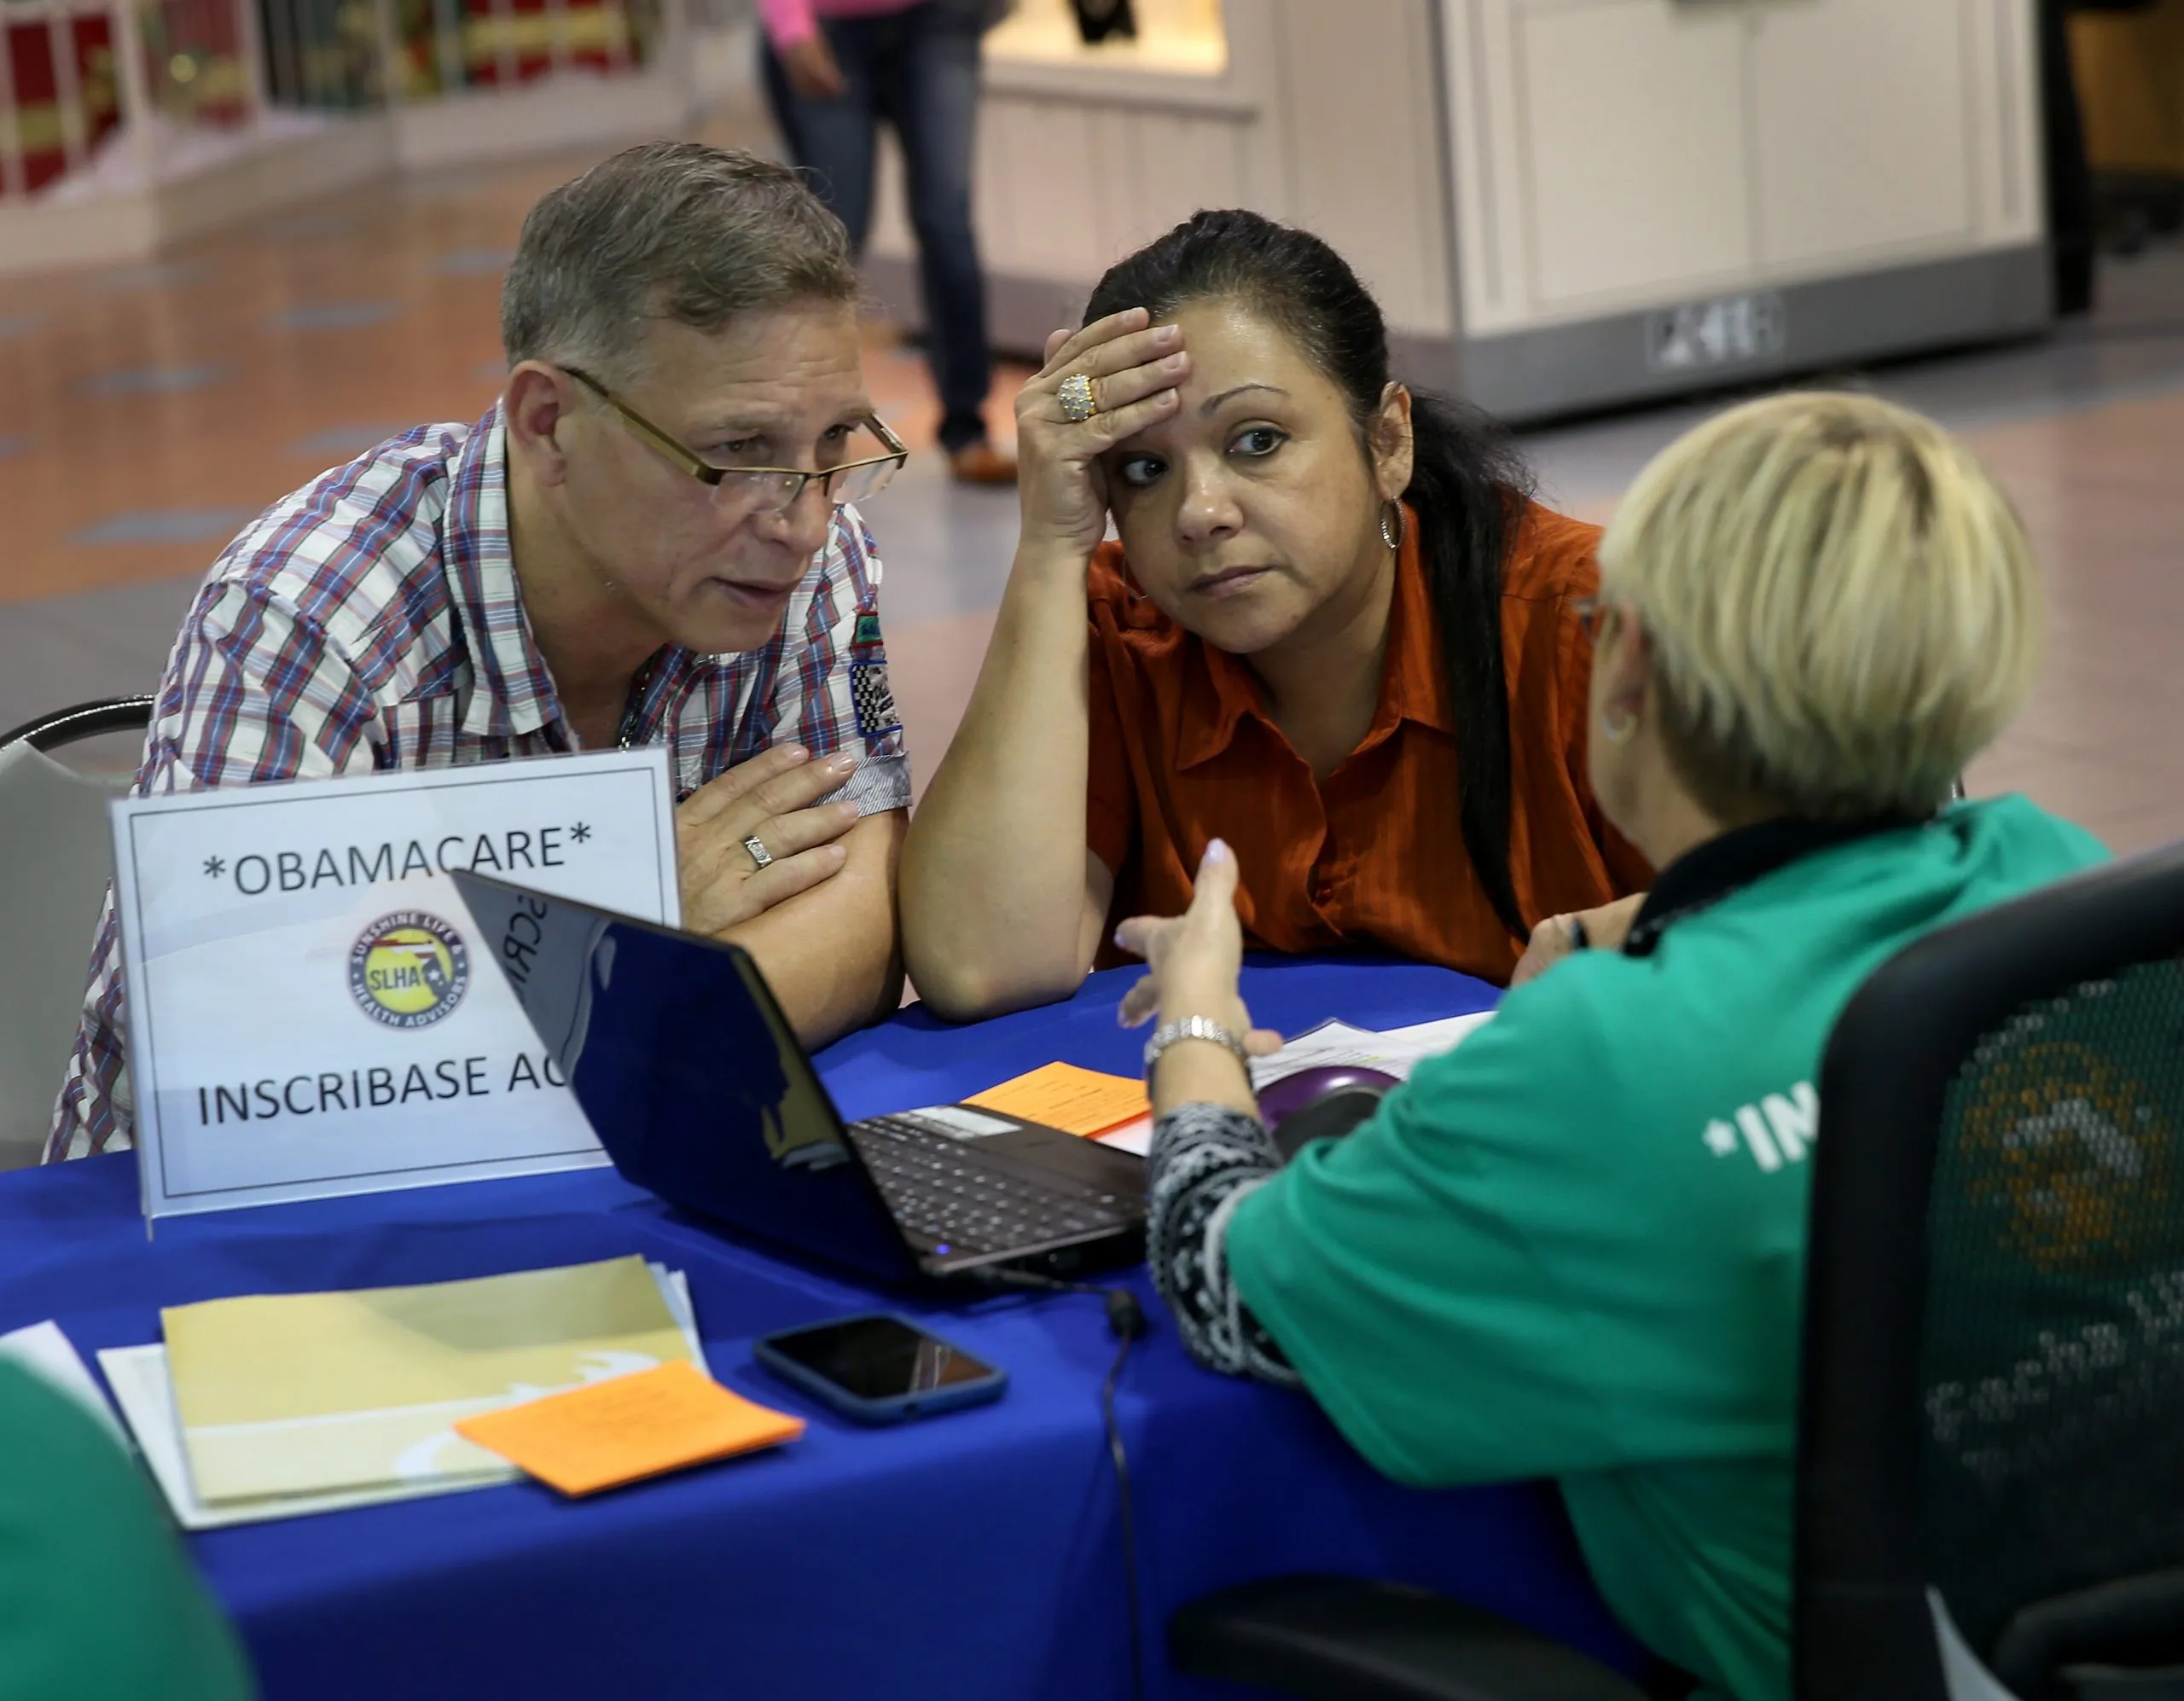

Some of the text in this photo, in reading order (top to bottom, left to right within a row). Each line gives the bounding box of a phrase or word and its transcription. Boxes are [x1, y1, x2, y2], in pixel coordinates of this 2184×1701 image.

[351, 911, 418, 965] SUNSHINE
[422, 915, 456, 943] LIFE
[352, 975, 467, 1027] HEALTH ADVISORS
[369, 965, 421, 991] SLHA
[199, 1055, 491, 1127] INSCRIBASE
